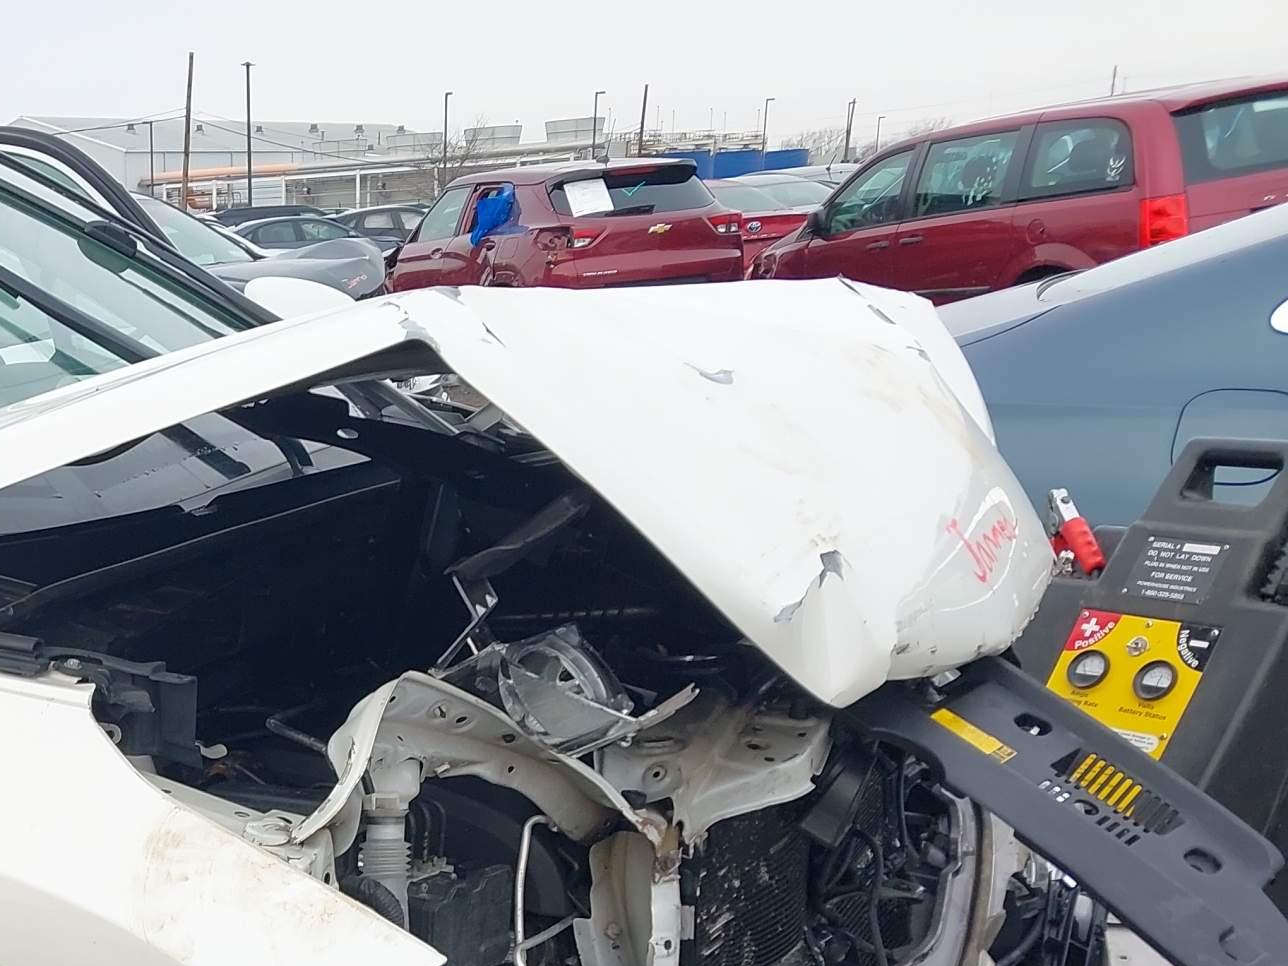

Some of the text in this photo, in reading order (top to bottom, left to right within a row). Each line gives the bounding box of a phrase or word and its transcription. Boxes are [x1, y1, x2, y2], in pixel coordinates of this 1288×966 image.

[1152, 541, 1175, 550] SERIAL
[1147, 549, 1159, 557] DO
[1191, 555, 1213, 563] DOWN
[1150, 571, 1193, 583] FOR SERVICE
[1074, 622, 1116, 650] Positive
[1177, 629, 1200, 669] Negative
[1118, 706, 1167, 721] Battery Status
